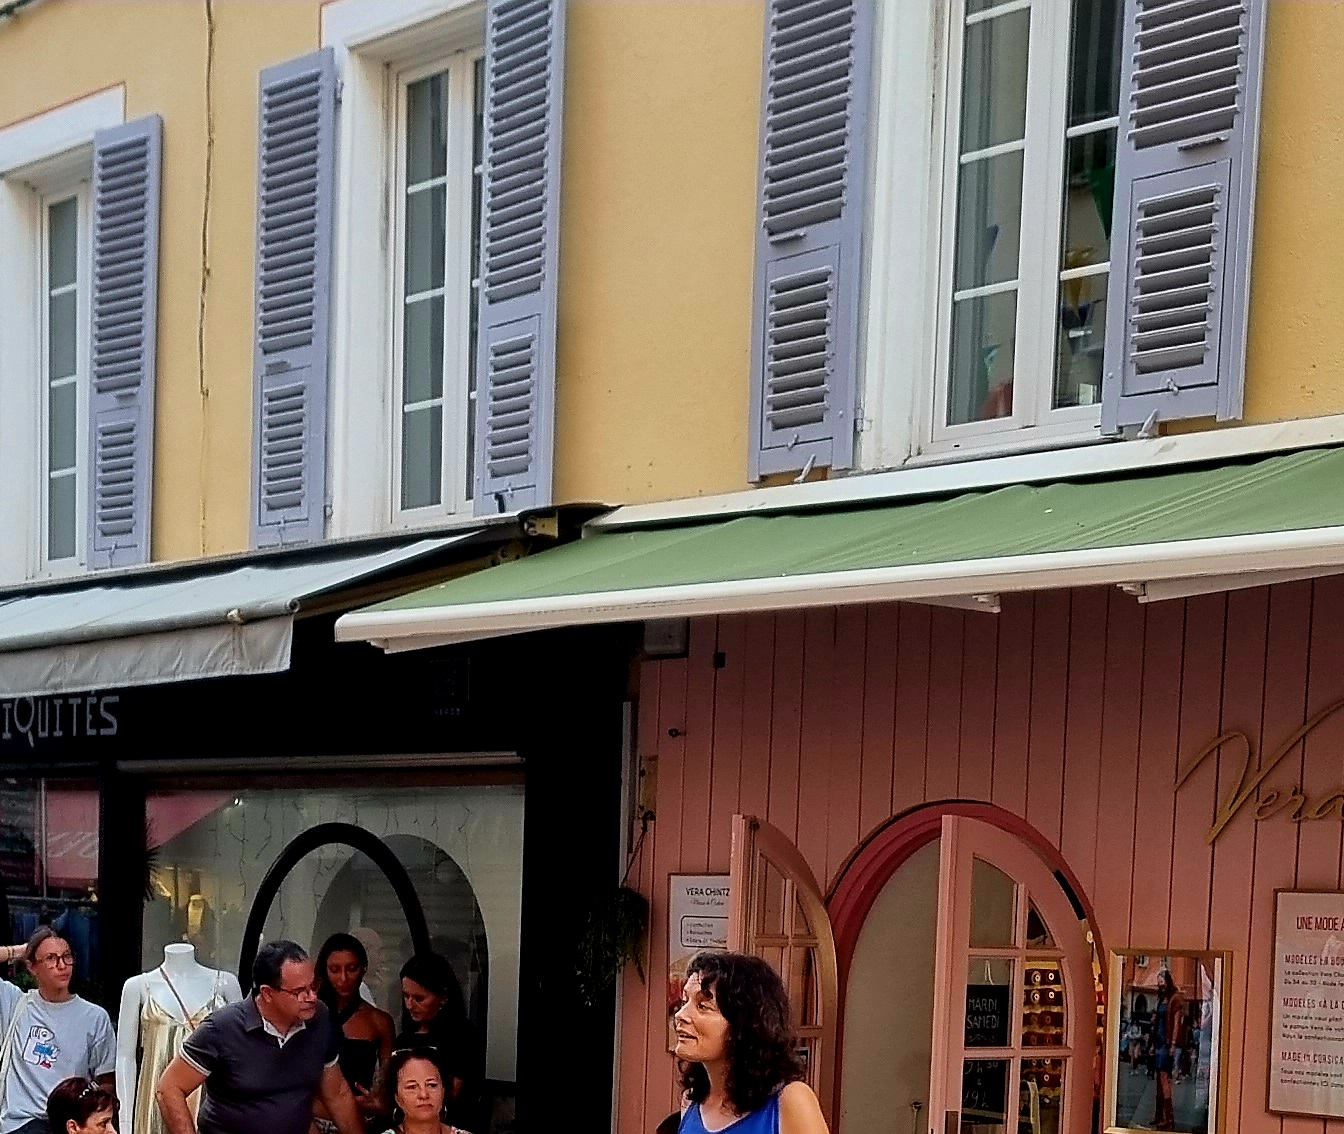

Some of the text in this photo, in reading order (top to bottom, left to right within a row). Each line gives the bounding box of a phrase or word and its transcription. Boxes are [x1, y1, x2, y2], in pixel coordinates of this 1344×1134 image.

[1296, 917, 1313, 930] UNE
[1314, 917, 1339, 931] MODE
[1330, 999, 1339, 1010] LA
[1281, 1051, 1301, 1062] MADE
[1313, 1053, 1344, 1065] CORSICA
